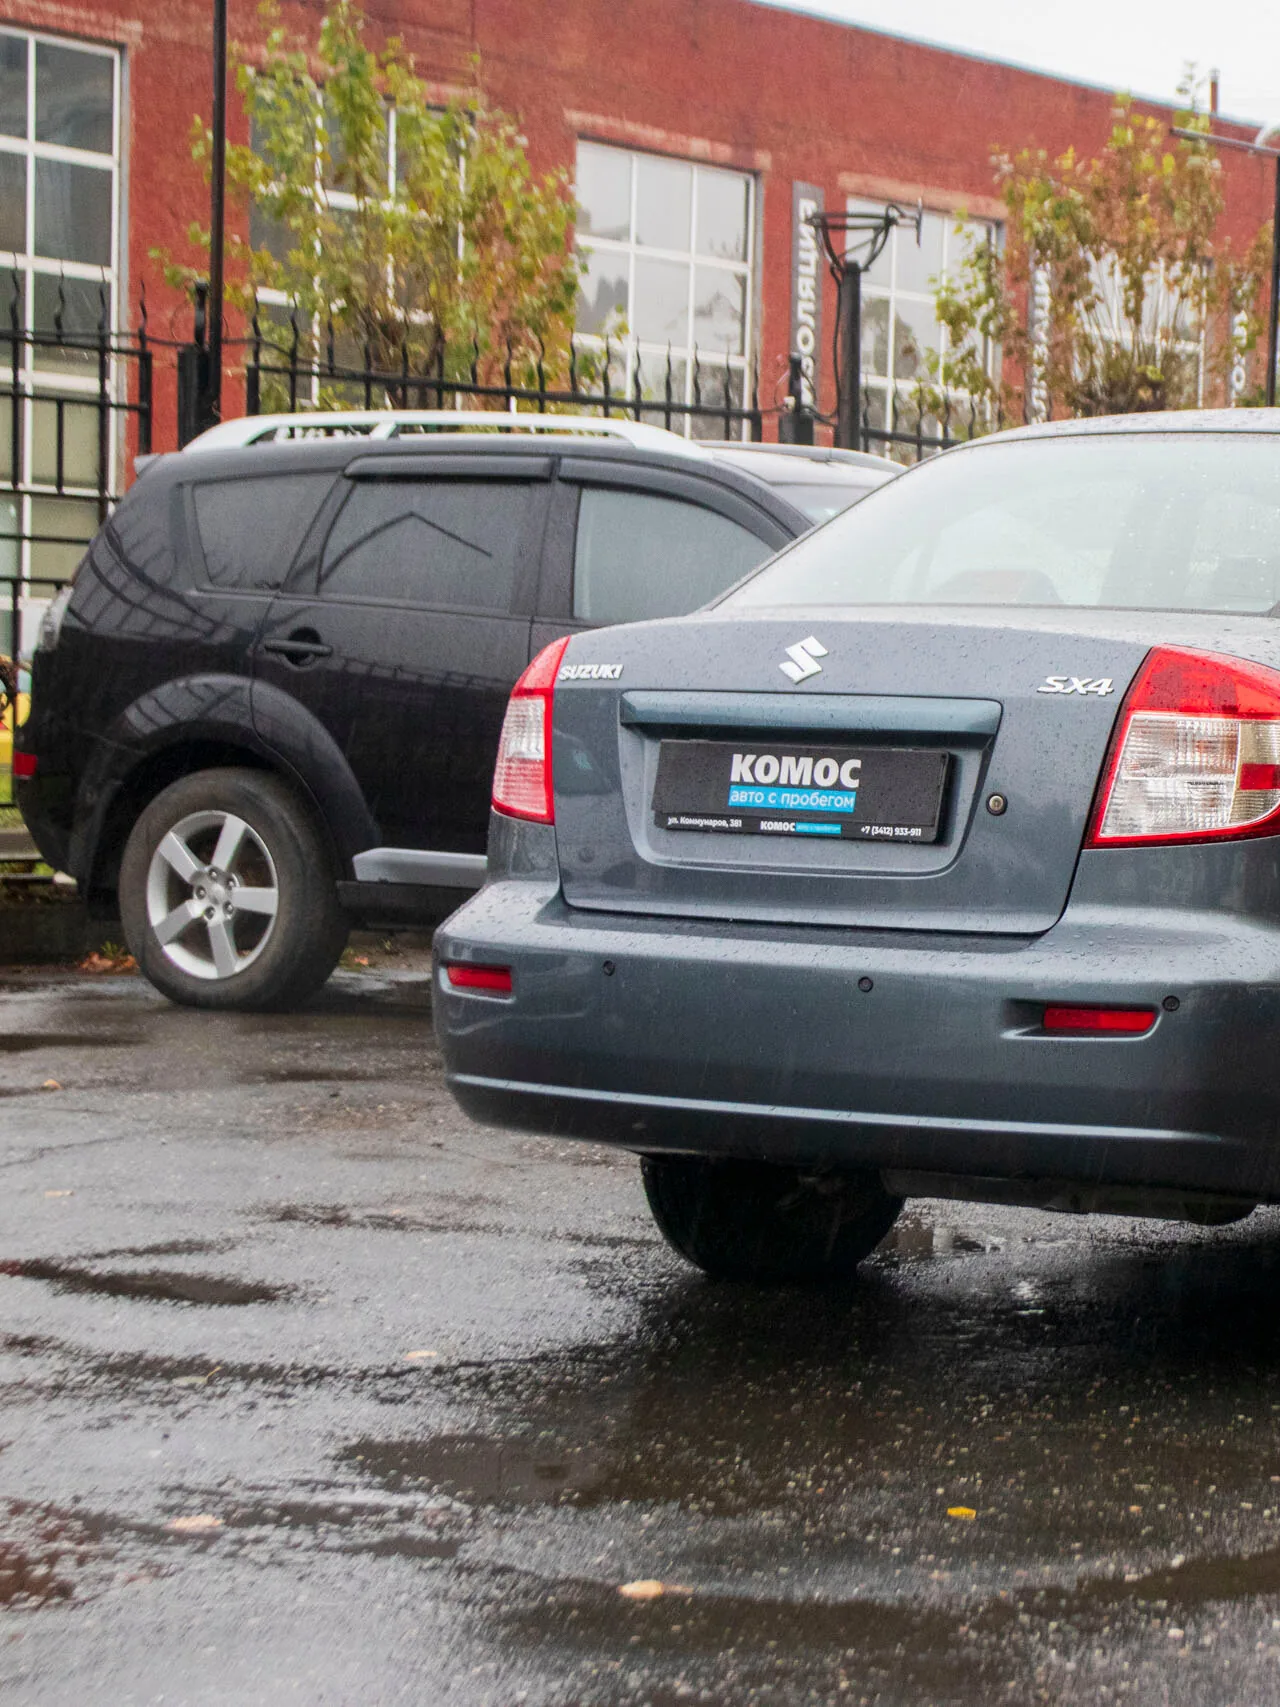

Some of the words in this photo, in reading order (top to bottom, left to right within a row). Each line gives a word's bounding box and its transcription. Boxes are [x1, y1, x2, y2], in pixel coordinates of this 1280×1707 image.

[558, 663, 624, 681] SUZUKI
[1037, 676, 1114, 696] SX4
[730, 753, 862, 789] КОМОС
[730, 789, 765, 804] авто
[767, 792, 777, 804] с
[780, 791, 855, 809] пробегом
[760, 820, 796, 832] КОМОС
[860, 825, 871, 835] +7
